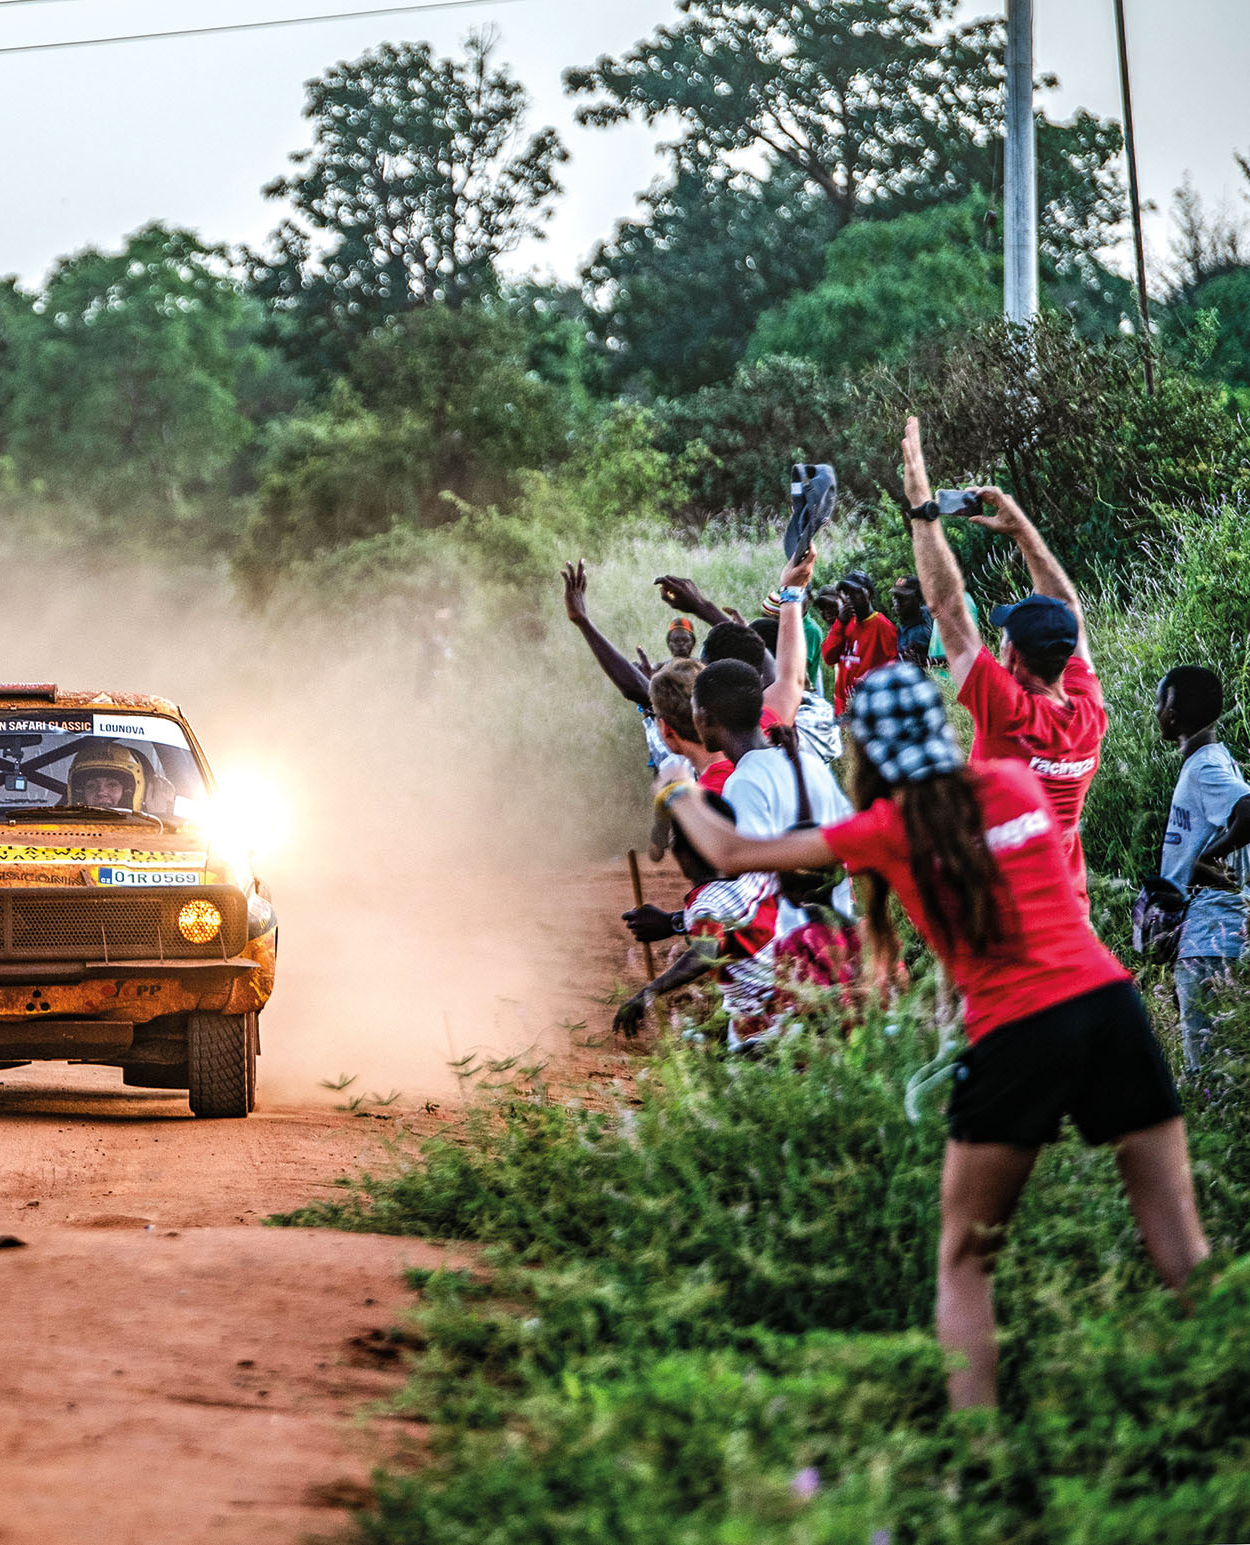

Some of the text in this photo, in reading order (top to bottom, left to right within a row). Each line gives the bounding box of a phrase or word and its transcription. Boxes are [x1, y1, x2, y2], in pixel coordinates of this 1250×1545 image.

[8, 720, 46, 731] SAFARI
[48, 721, 92, 732] CLASSIC
[99, 723, 145, 736] LOUNOVA
[114, 871, 196, 884] 01R 0569
